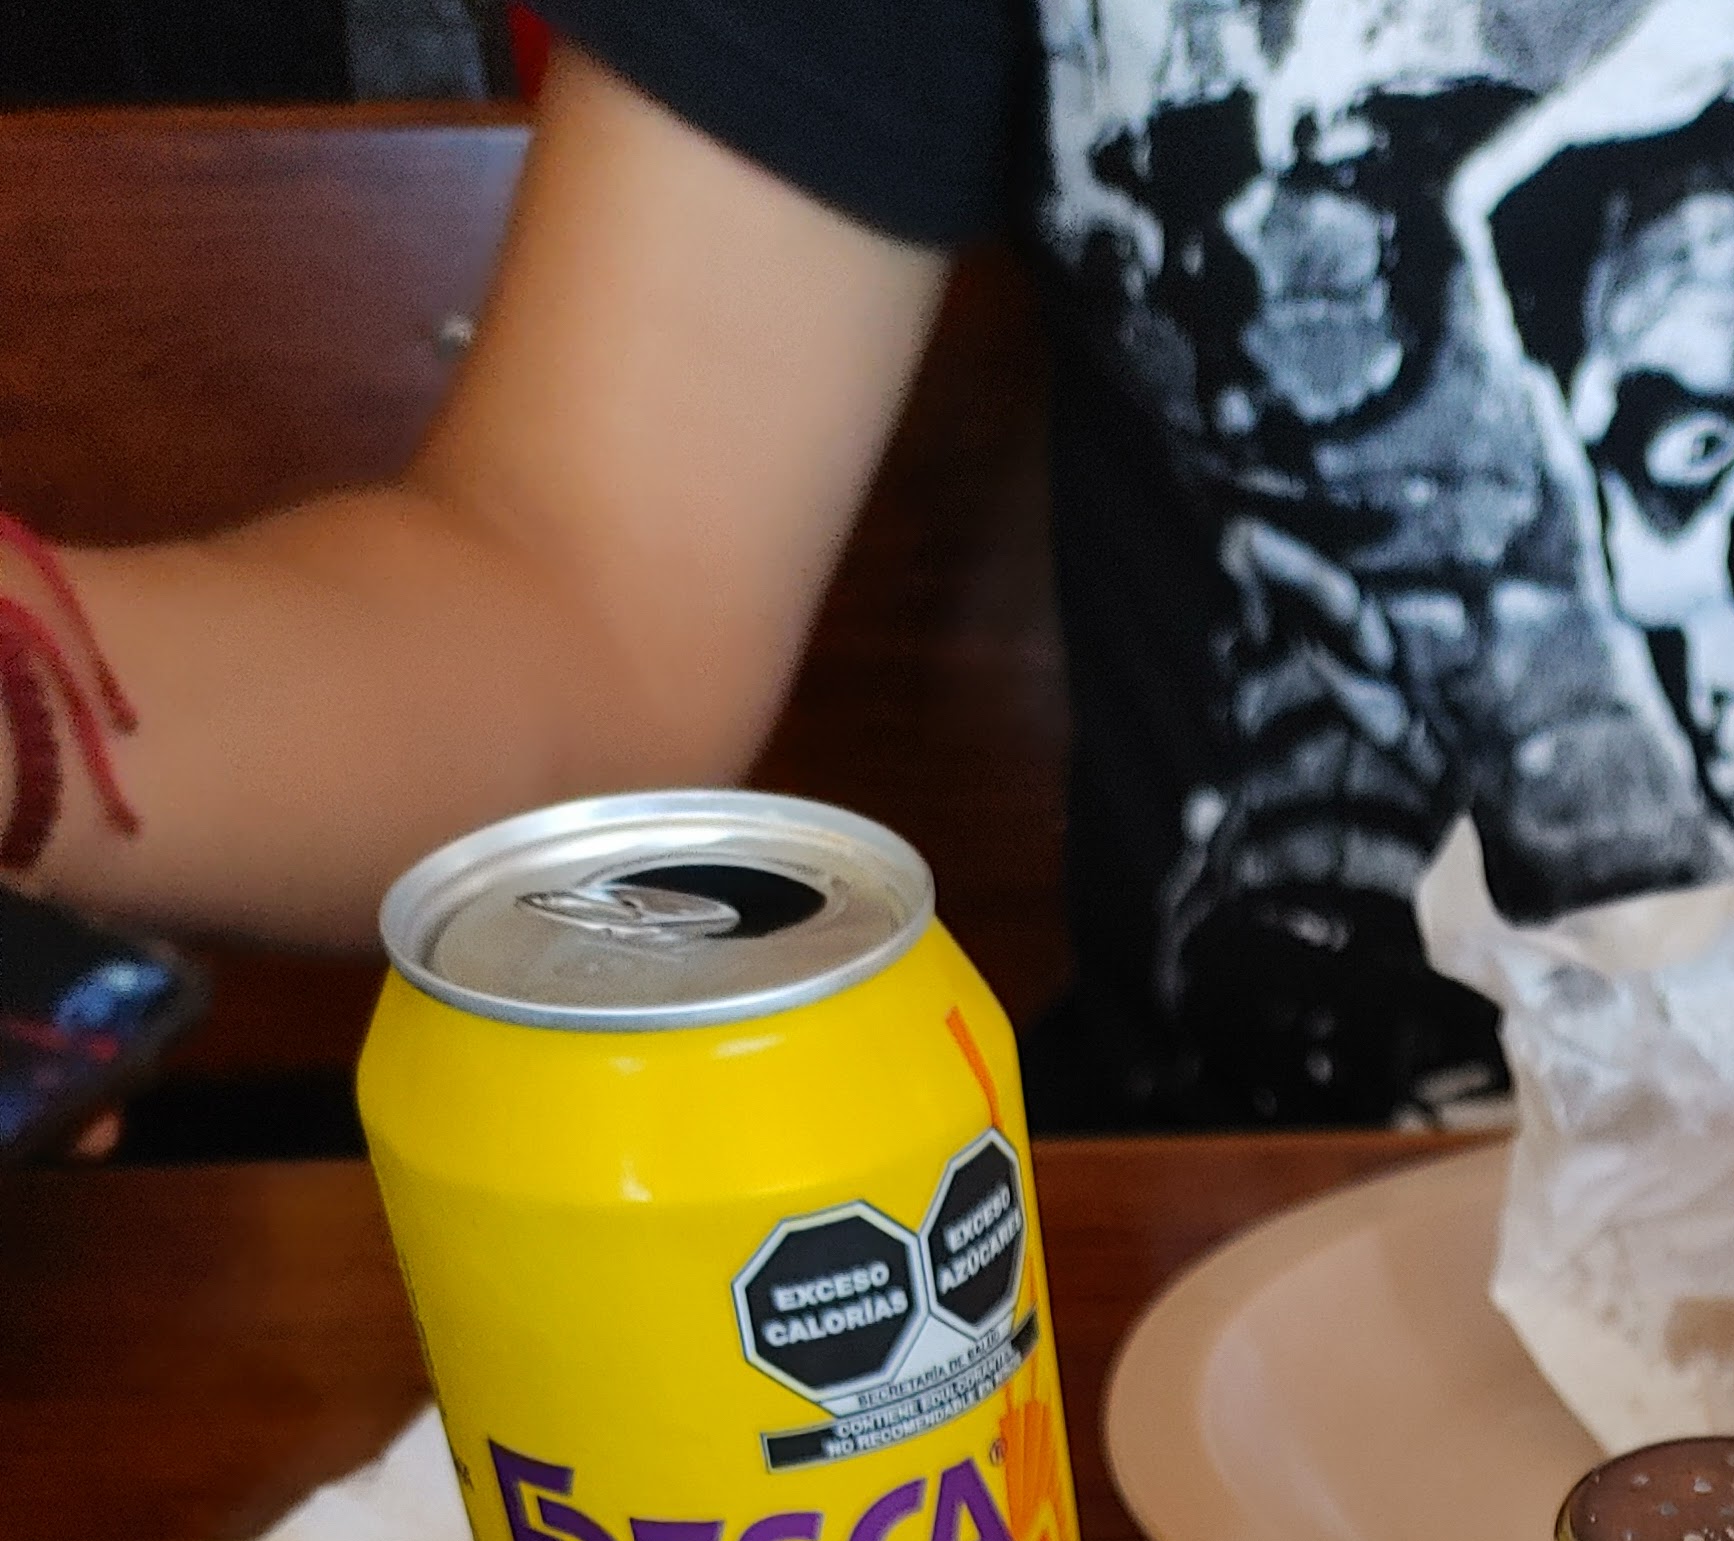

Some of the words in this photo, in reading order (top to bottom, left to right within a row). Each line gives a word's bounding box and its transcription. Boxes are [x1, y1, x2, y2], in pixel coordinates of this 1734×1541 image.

[944, 1183, 1011, 1254] EXCESO
[773, 1261, 890, 1311] EXCESO
[764, 1289, 908, 1346] CALORÍAS
[822, 1437, 854, 1458] NO
